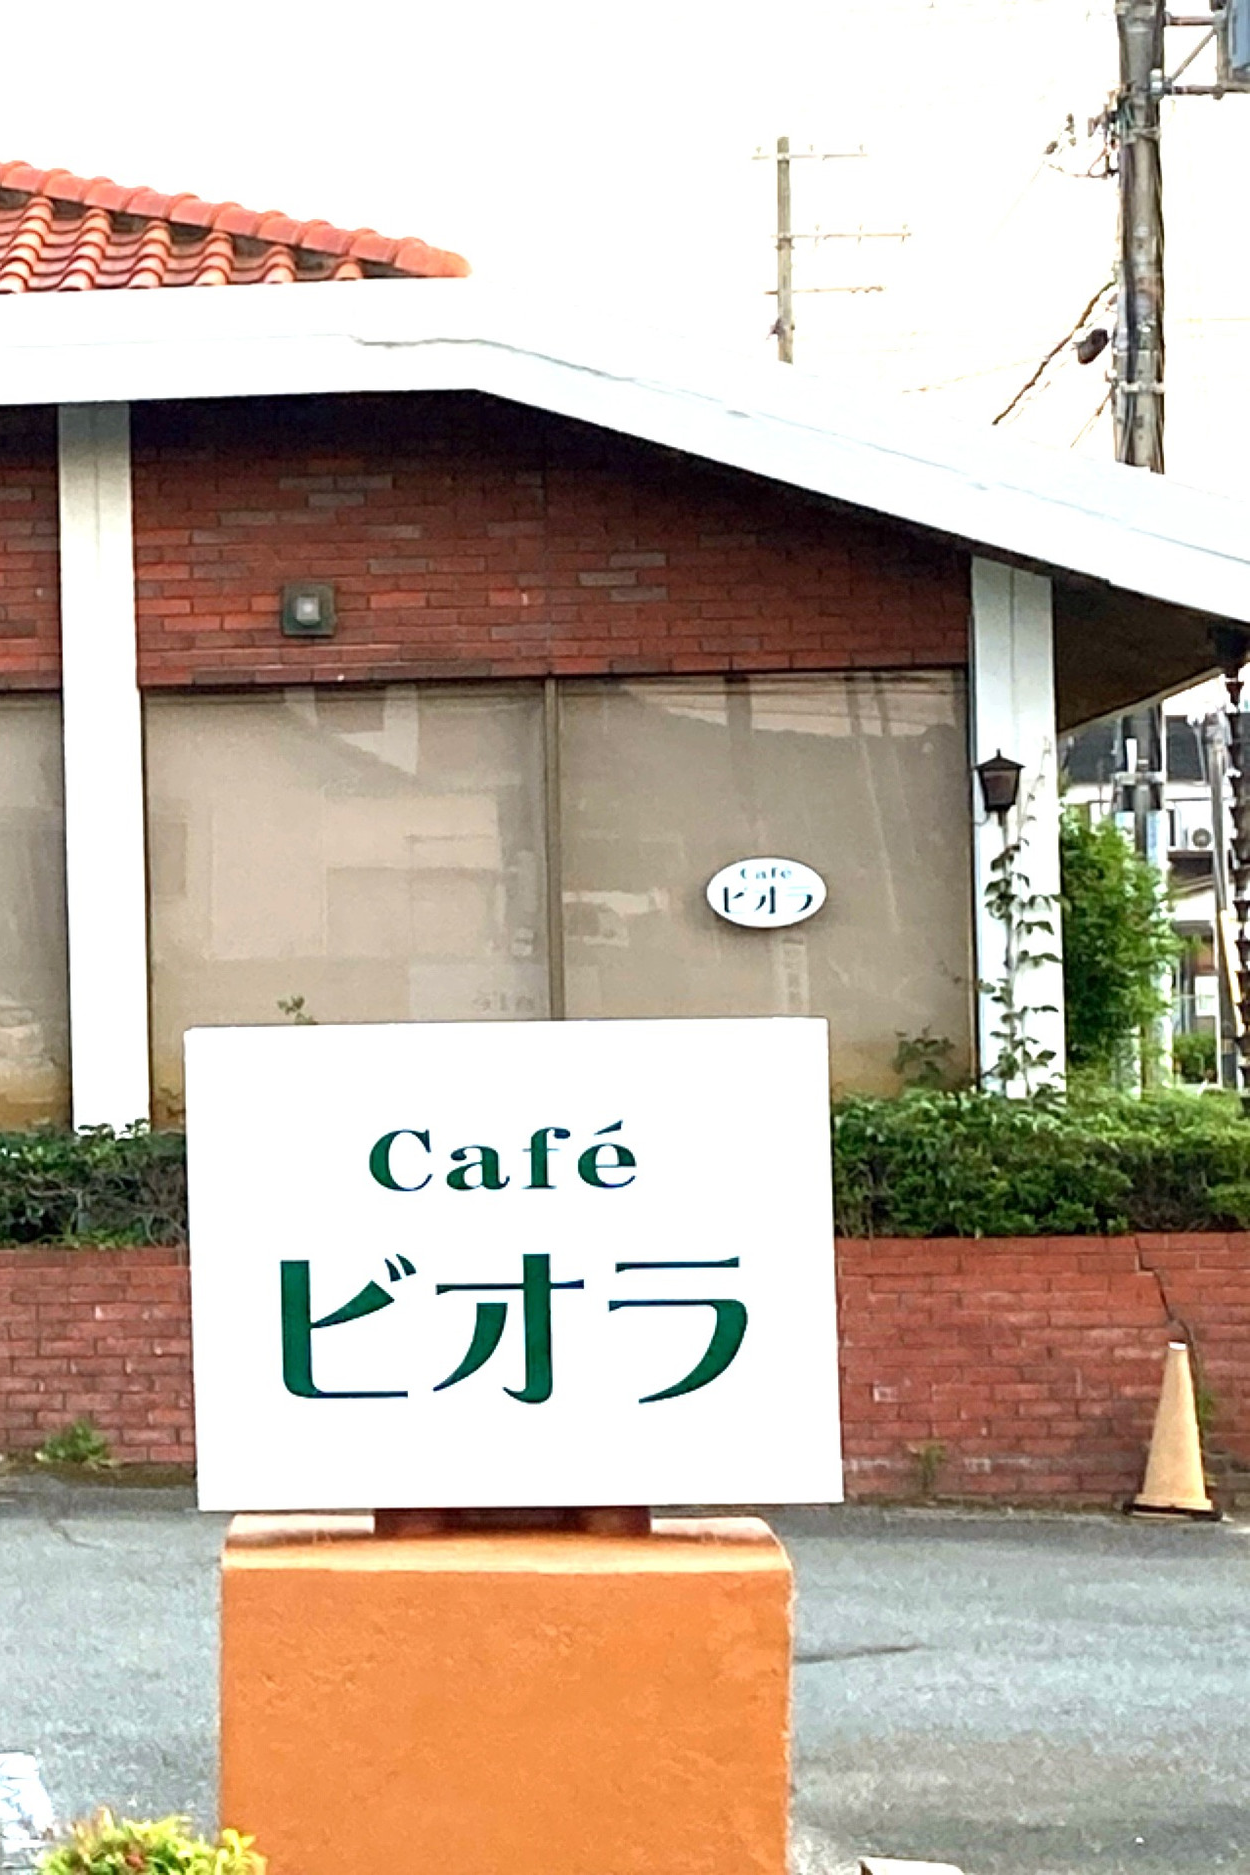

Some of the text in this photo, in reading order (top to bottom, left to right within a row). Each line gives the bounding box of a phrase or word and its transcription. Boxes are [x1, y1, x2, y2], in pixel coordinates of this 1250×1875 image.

[369, 1119, 637, 1191] Café
[280, 1253, 748, 1404] ビオラ
